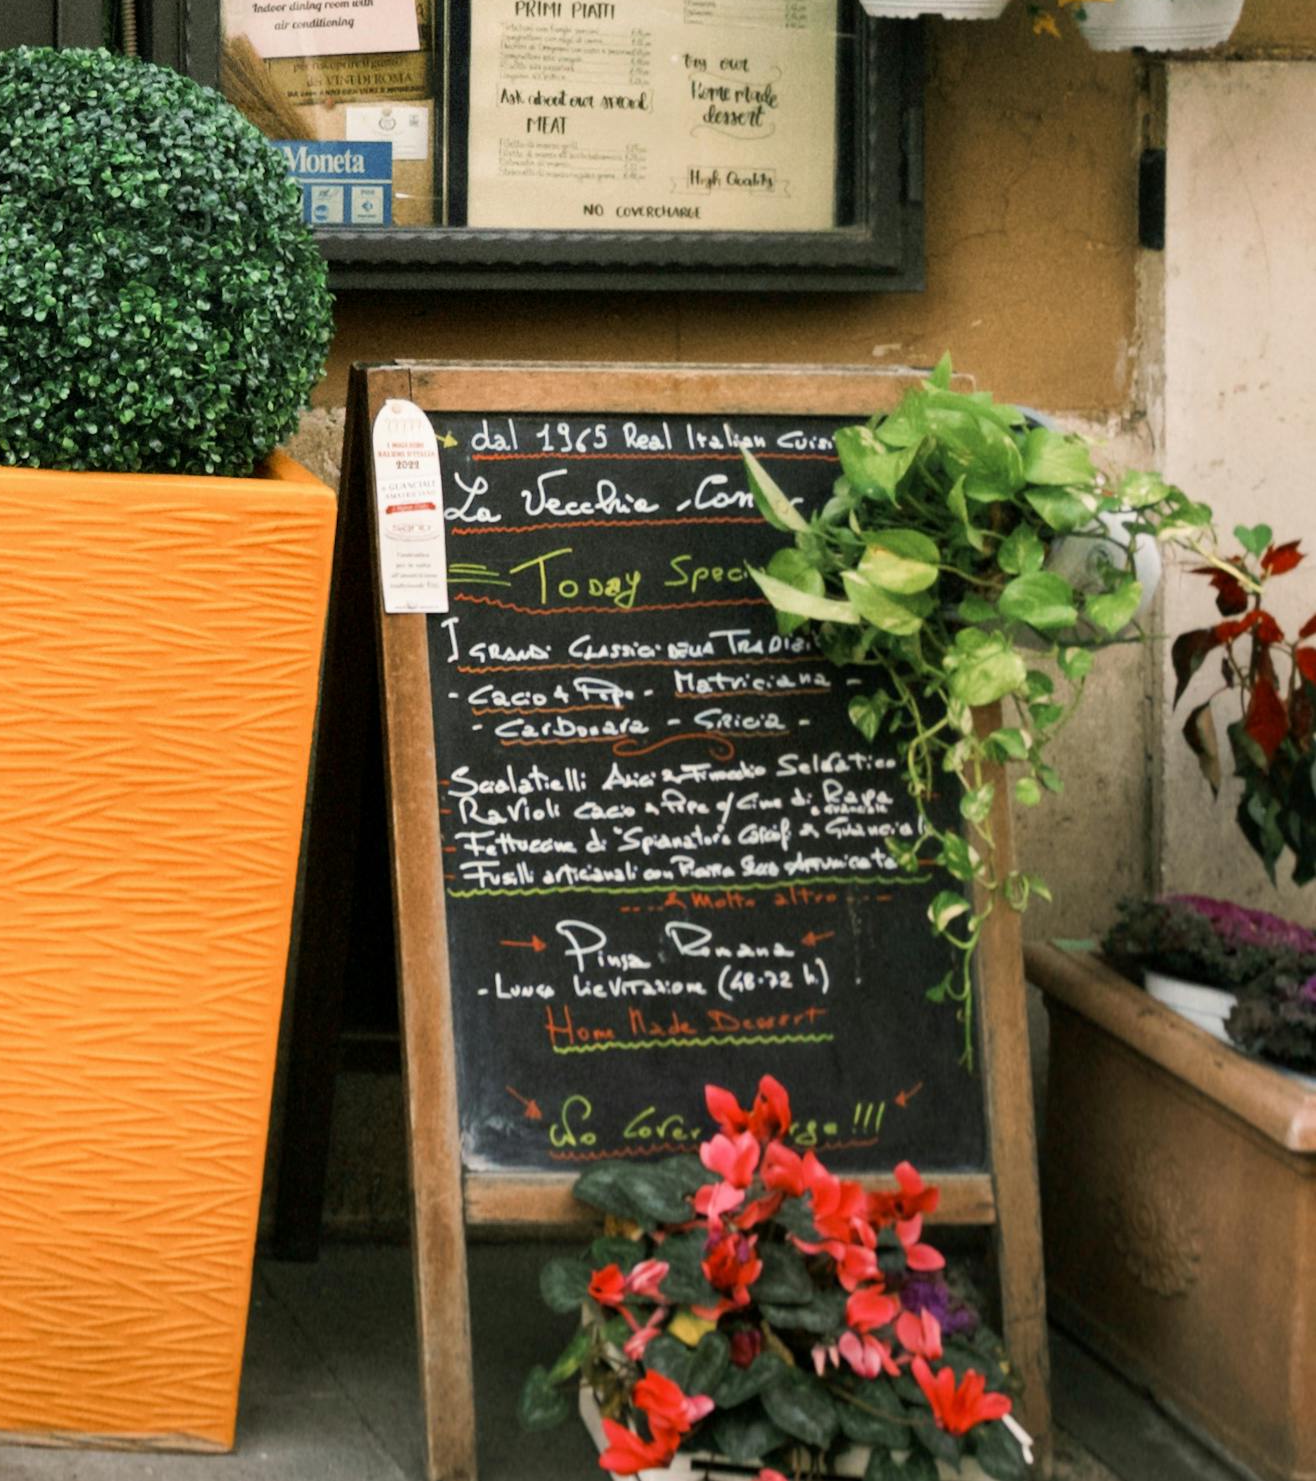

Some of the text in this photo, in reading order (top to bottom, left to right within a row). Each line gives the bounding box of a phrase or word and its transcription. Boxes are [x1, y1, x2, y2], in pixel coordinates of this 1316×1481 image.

[252, 3, 287, 13] Indoor
[289, 0, 323, 13] dining
[324, 0, 351, 10] room
[571, 1, 615, 20] PIATTI
[274, 16, 355, 31] air conditioning
[500, 87, 525, 106] Ask
[569, 95, 594, 109] our
[526, 115, 567, 134] MEAT
[703, 104, 765, 127] dessert
[282, 145, 366, 174] Moneta
[690, 168, 774, 192] High Quality
[583, 203, 604, 217] NO
[471, 419, 836, 453] dal 1965 Real Italian Cuisi
[396, 460, 420, 470] 2022
[443, 470, 502, 523] La
[521, 469, 659, 516] Vecchia
[510, 547, 764, 609] Today Speci
[441, 616, 460, 663] I
[468, 684, 548, 707] Cacio
[674, 669, 831, 694] Matriciana
[822, 778, 894, 806] Rapa
[824, 816, 926, 839] Guancial
[774, 886, 838, 907] altro
[555, 919, 796, 972] Pinsa Romana
[545, 1004, 828, 1046] Home Made Dessert
[622, 1106, 701, 1142] Cover
